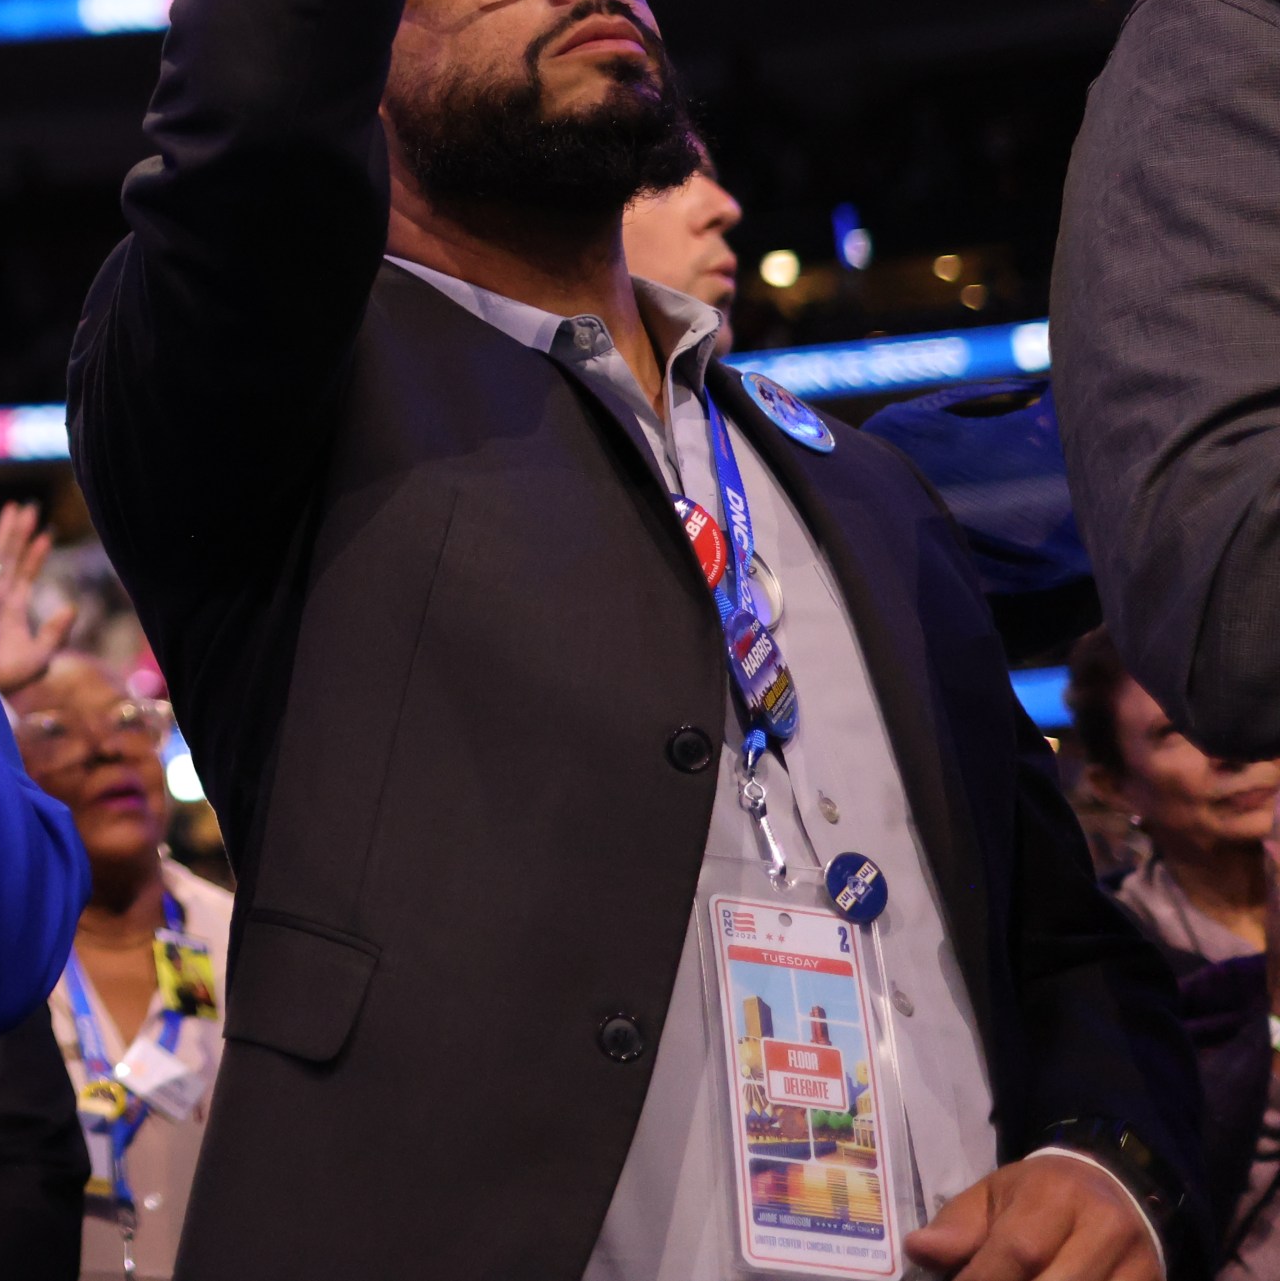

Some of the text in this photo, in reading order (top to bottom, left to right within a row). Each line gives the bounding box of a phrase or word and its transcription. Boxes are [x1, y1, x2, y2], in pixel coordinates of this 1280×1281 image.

[726, 486, 749, 551] DNC
[741, 633, 773, 679] HARRIS
[839, 865, 874, 907] I'm in!
[722, 909, 734, 937] DNC
[735, 931, 757, 940] 2024
[838, 926, 850, 953] 2
[762, 952, 819, 968] TUESDAY
[787, 1049, 819, 1071] FLOOR
[784, 1076, 829, 1099] DELEGATE
